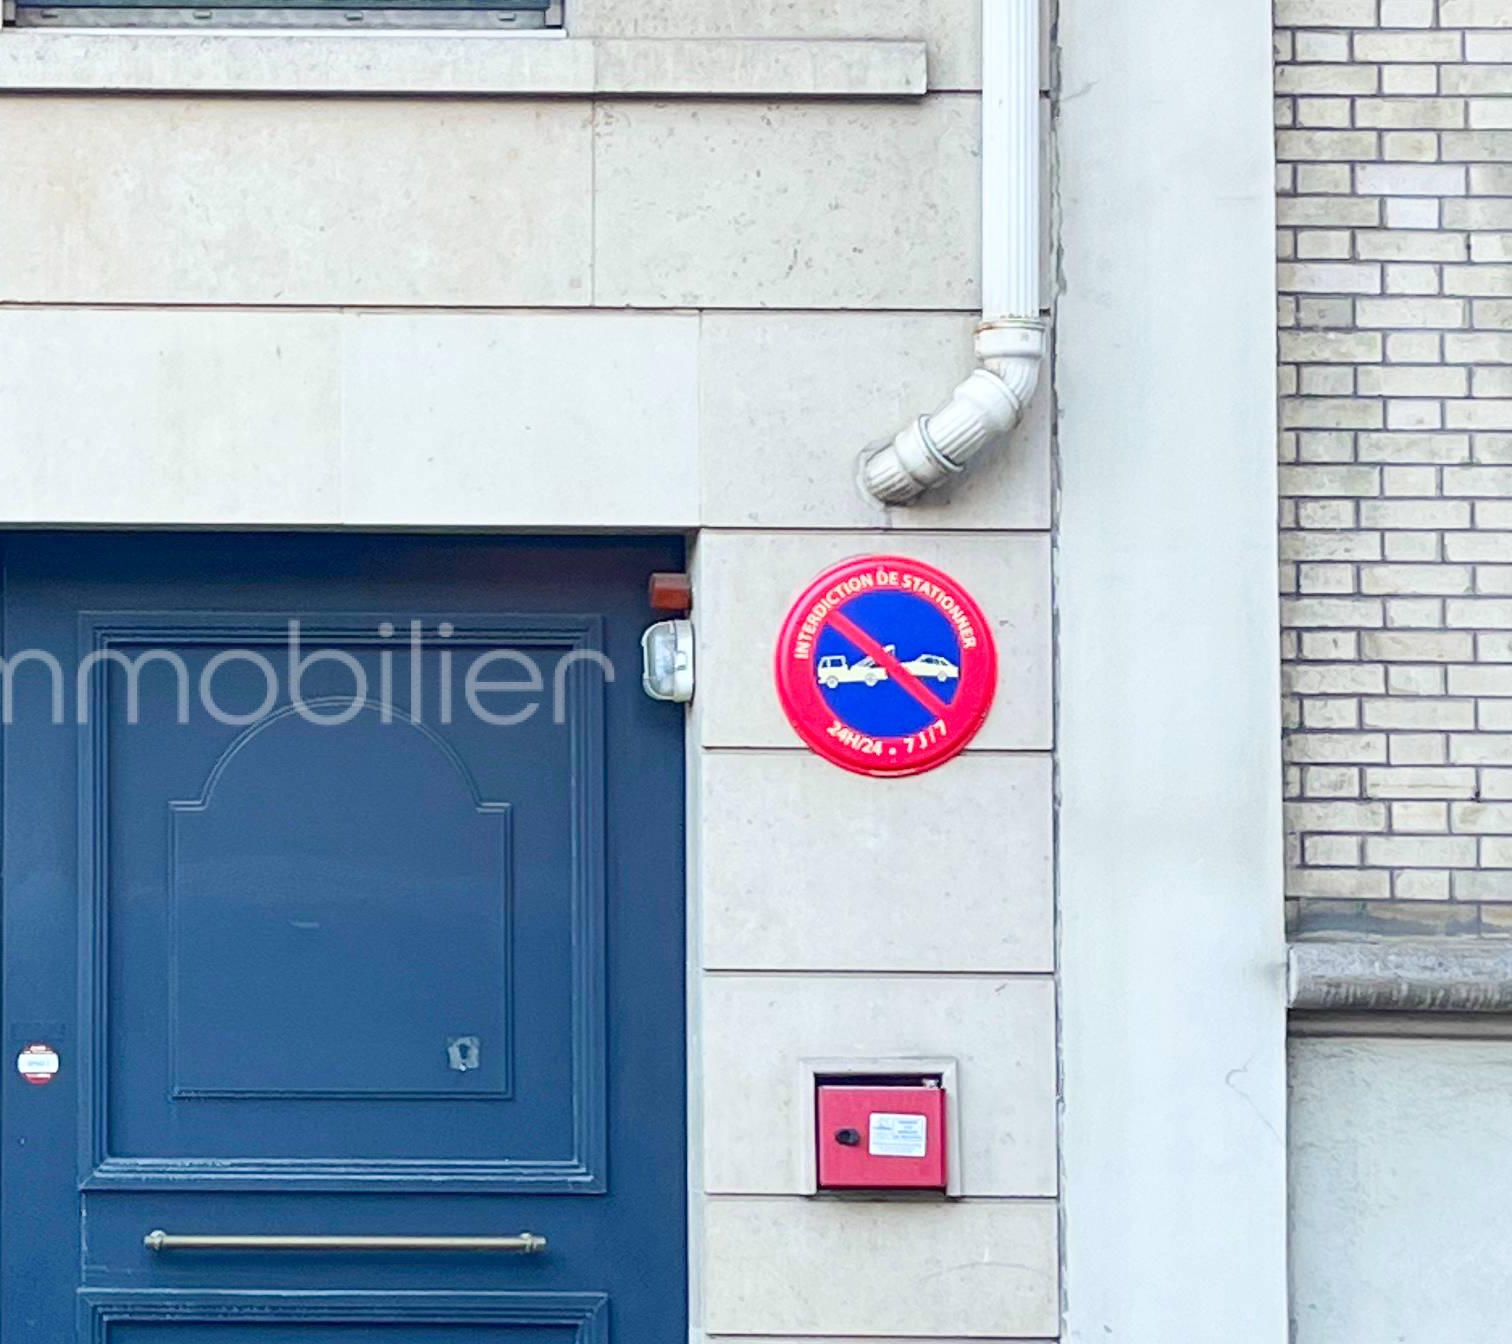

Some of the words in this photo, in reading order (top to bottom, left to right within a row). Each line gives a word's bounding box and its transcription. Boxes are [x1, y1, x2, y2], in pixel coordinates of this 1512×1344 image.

[794, 573, 874, 659] INTERDICTION
[876, 571, 899, 586] DE
[901, 574, 977, 649] STATIONNER
[826, 720, 883, 755] 24H/24
